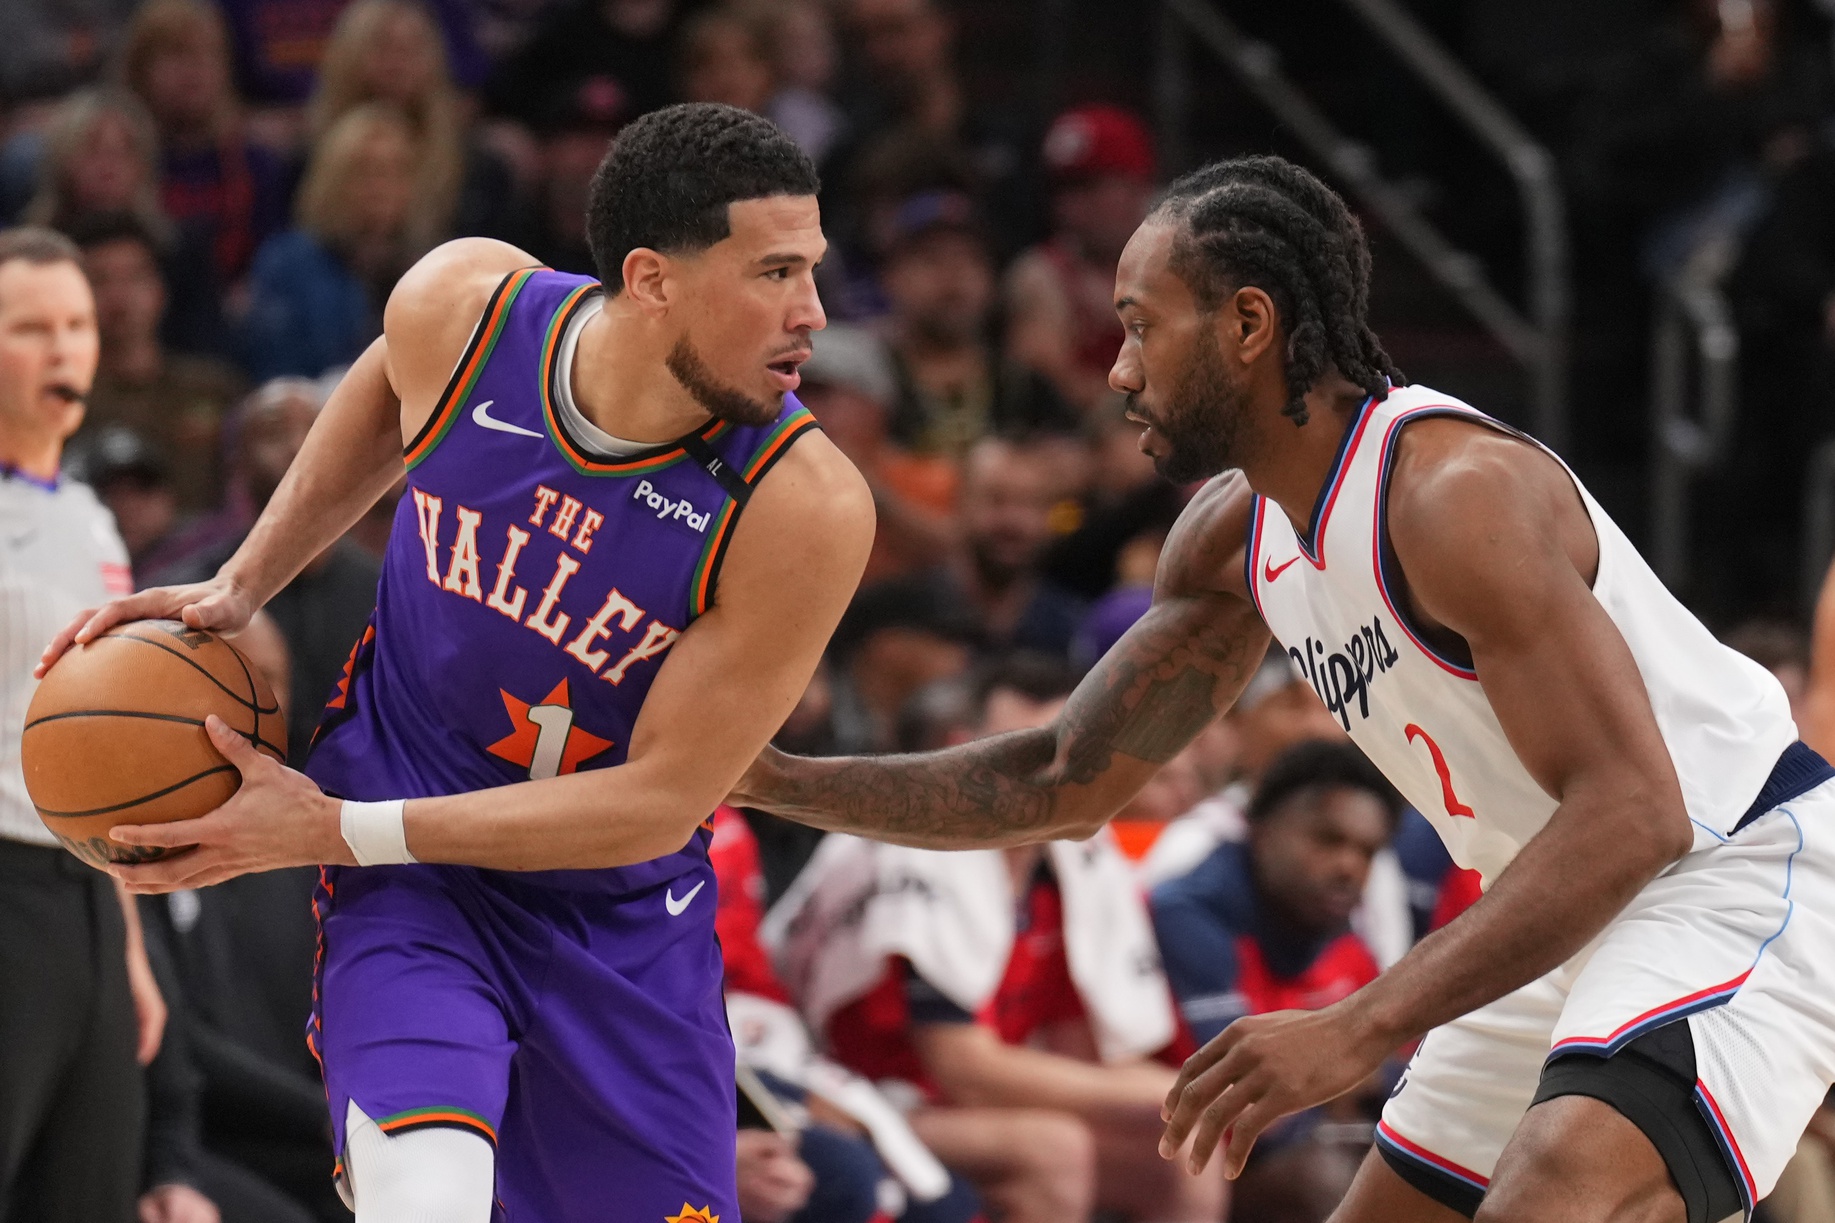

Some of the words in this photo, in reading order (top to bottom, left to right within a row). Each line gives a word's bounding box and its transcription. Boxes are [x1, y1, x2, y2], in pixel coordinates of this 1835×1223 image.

[706, 457, 722, 477] AL
[528, 484, 604, 554] THE
[633, 480, 711, 533] PayPal
[412, 486, 683, 686] VALLEY
[527, 704, 574, 780] 1
[1404, 723, 1475, 819] 2
